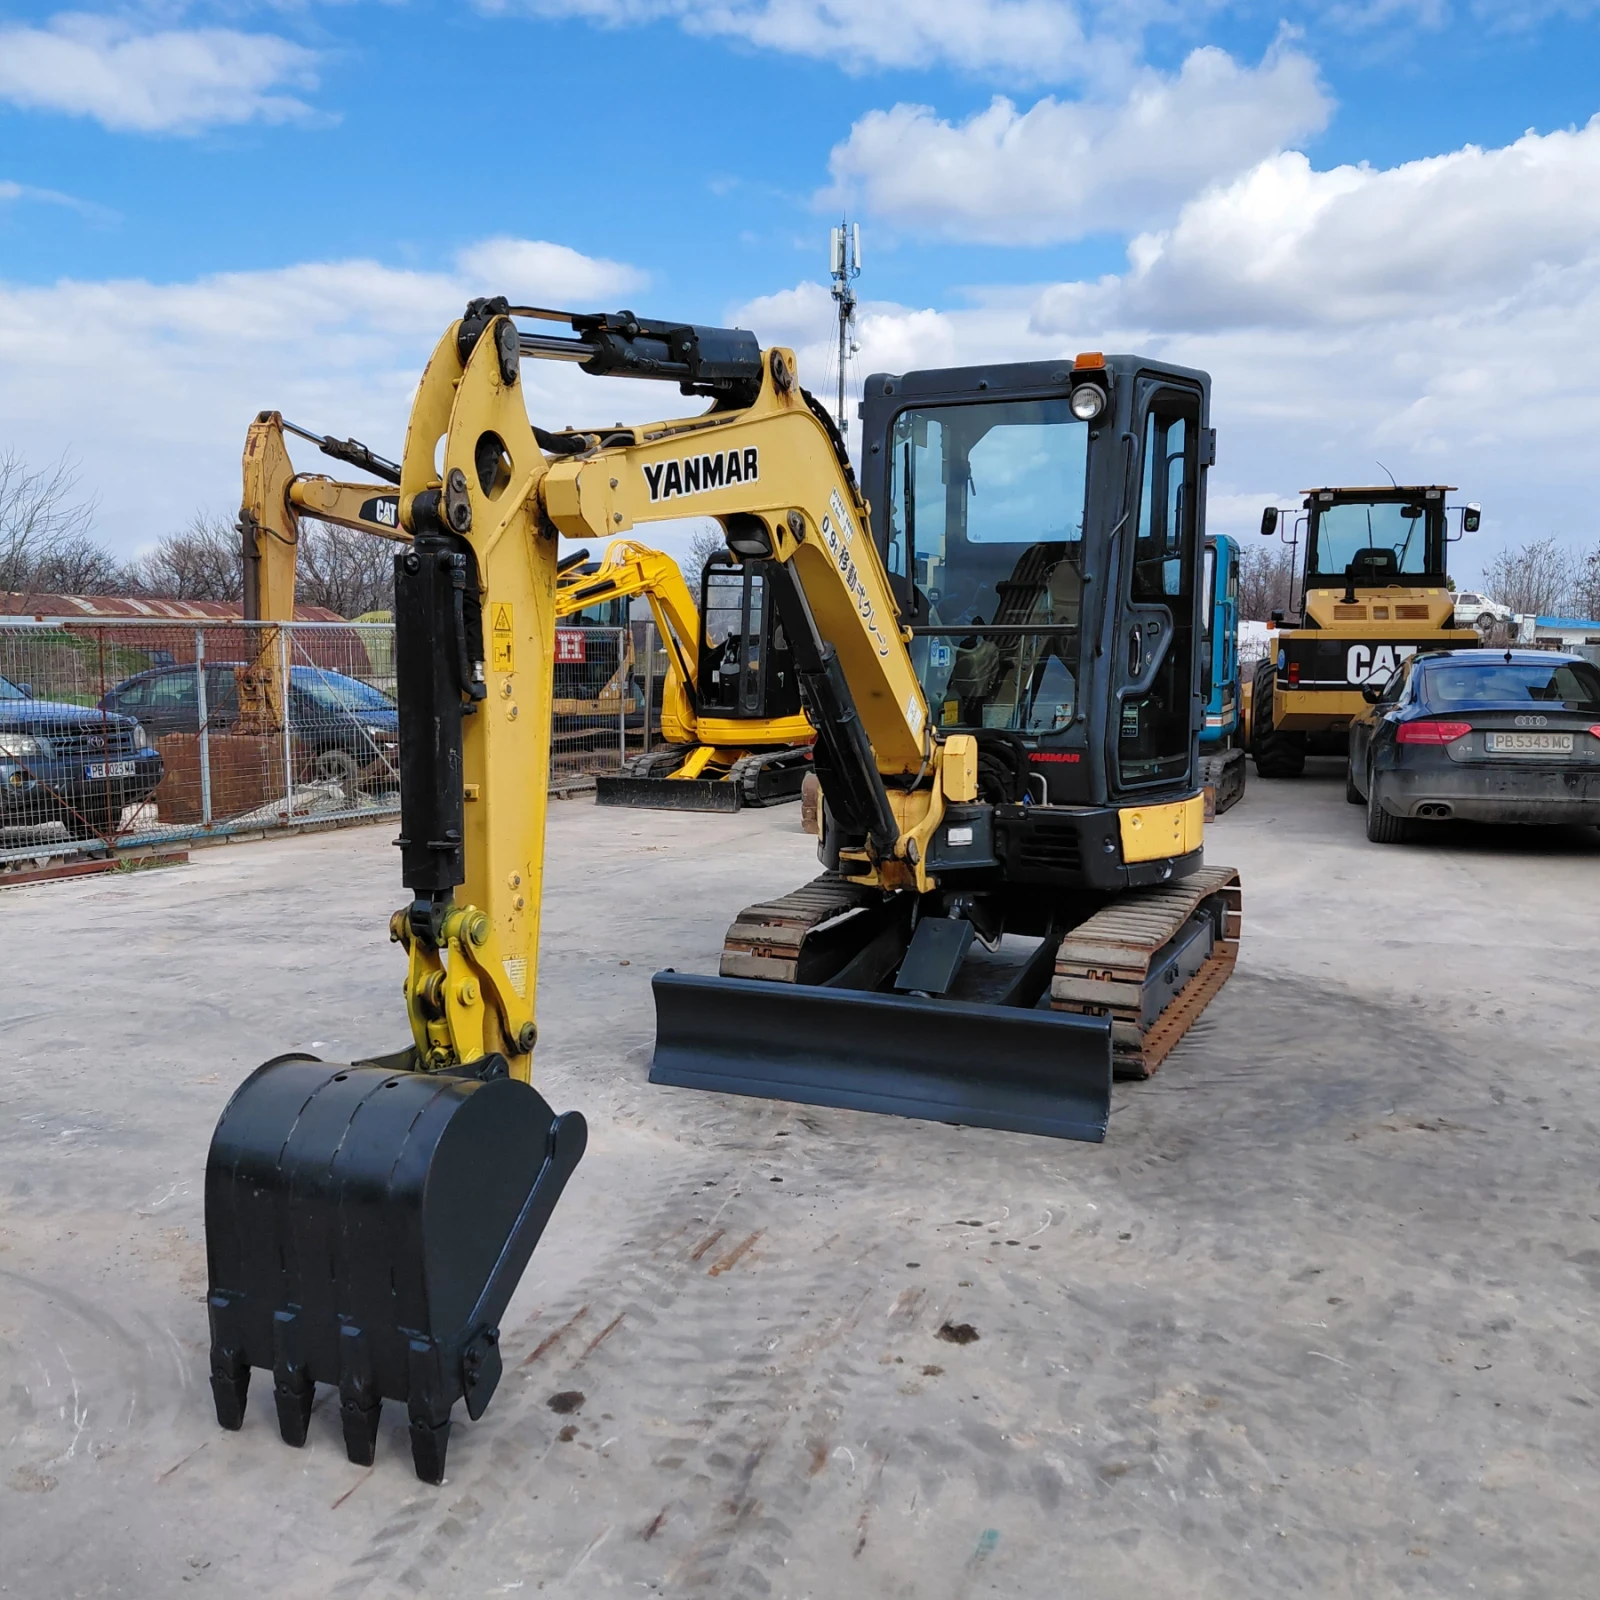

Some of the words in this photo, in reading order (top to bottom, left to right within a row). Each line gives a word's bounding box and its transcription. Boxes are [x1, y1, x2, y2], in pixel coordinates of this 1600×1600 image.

[643, 447, 758, 501] YANMAR
[376, 499, 397, 526] CAT
[1516, 735, 1550, 748] 5343
